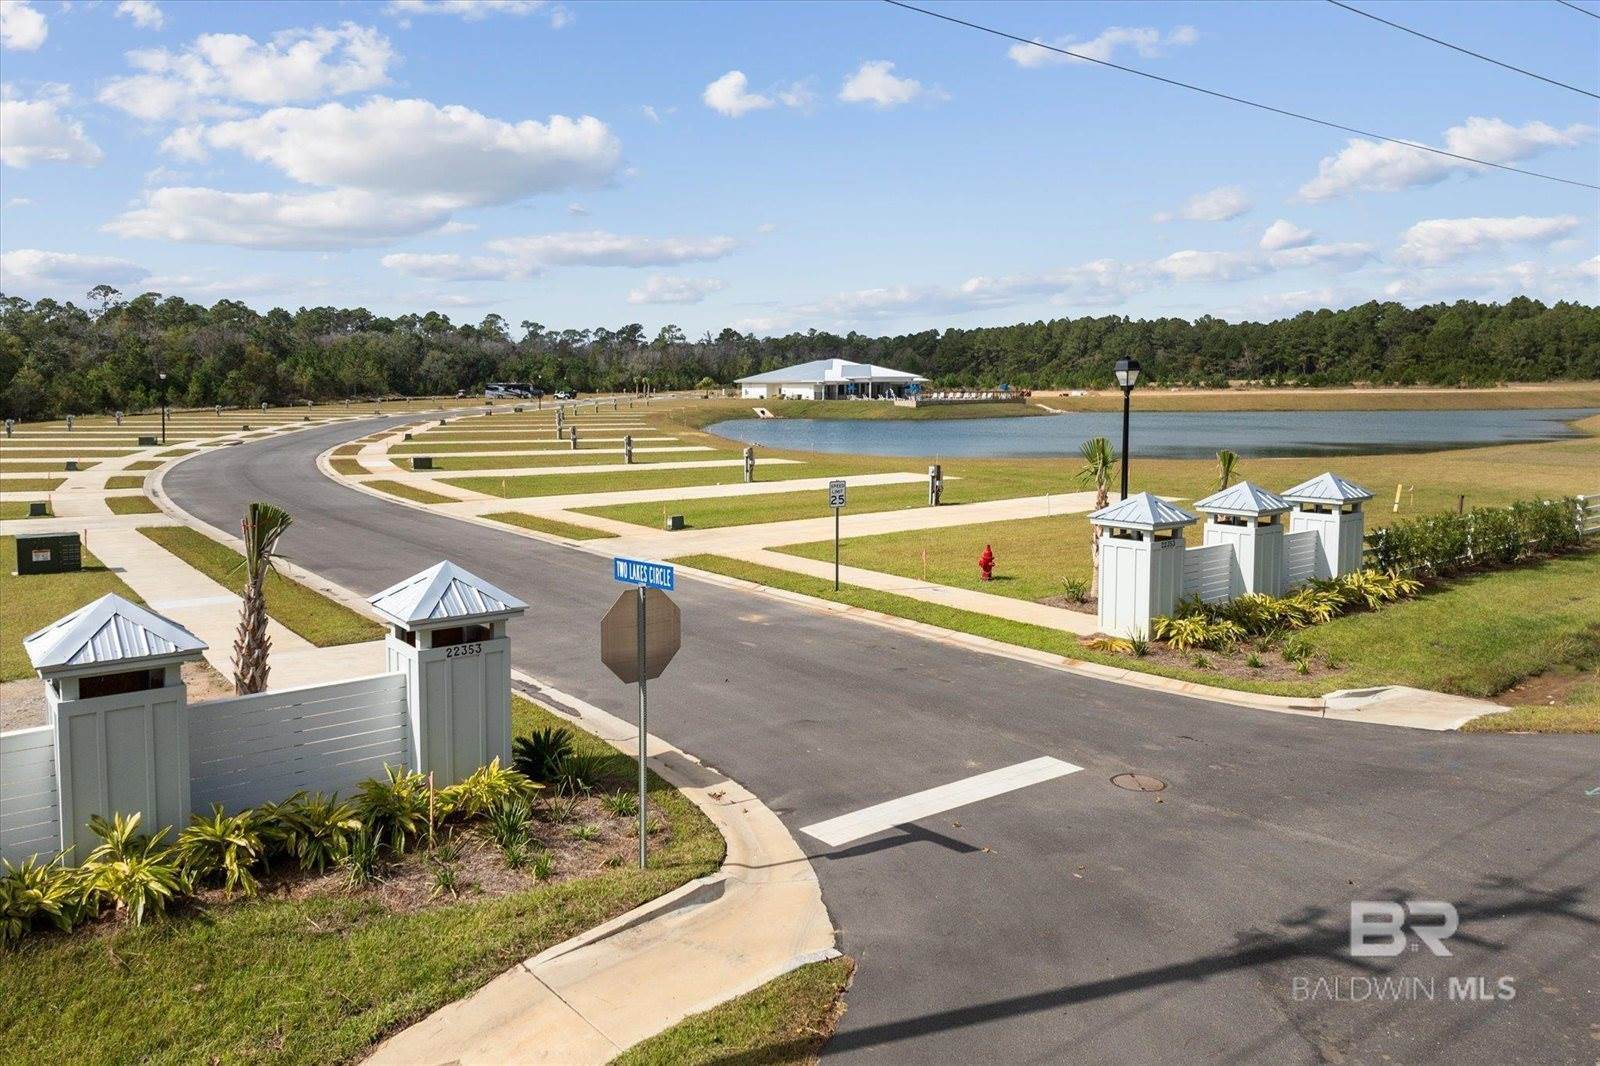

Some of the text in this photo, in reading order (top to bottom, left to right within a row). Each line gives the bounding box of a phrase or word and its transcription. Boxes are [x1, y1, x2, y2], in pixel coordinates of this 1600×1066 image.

[830, 495, 845, 505] 25
[616, 560, 672, 587] TWO LAKES CIRCLE
[446, 643, 482, 658] 22353
